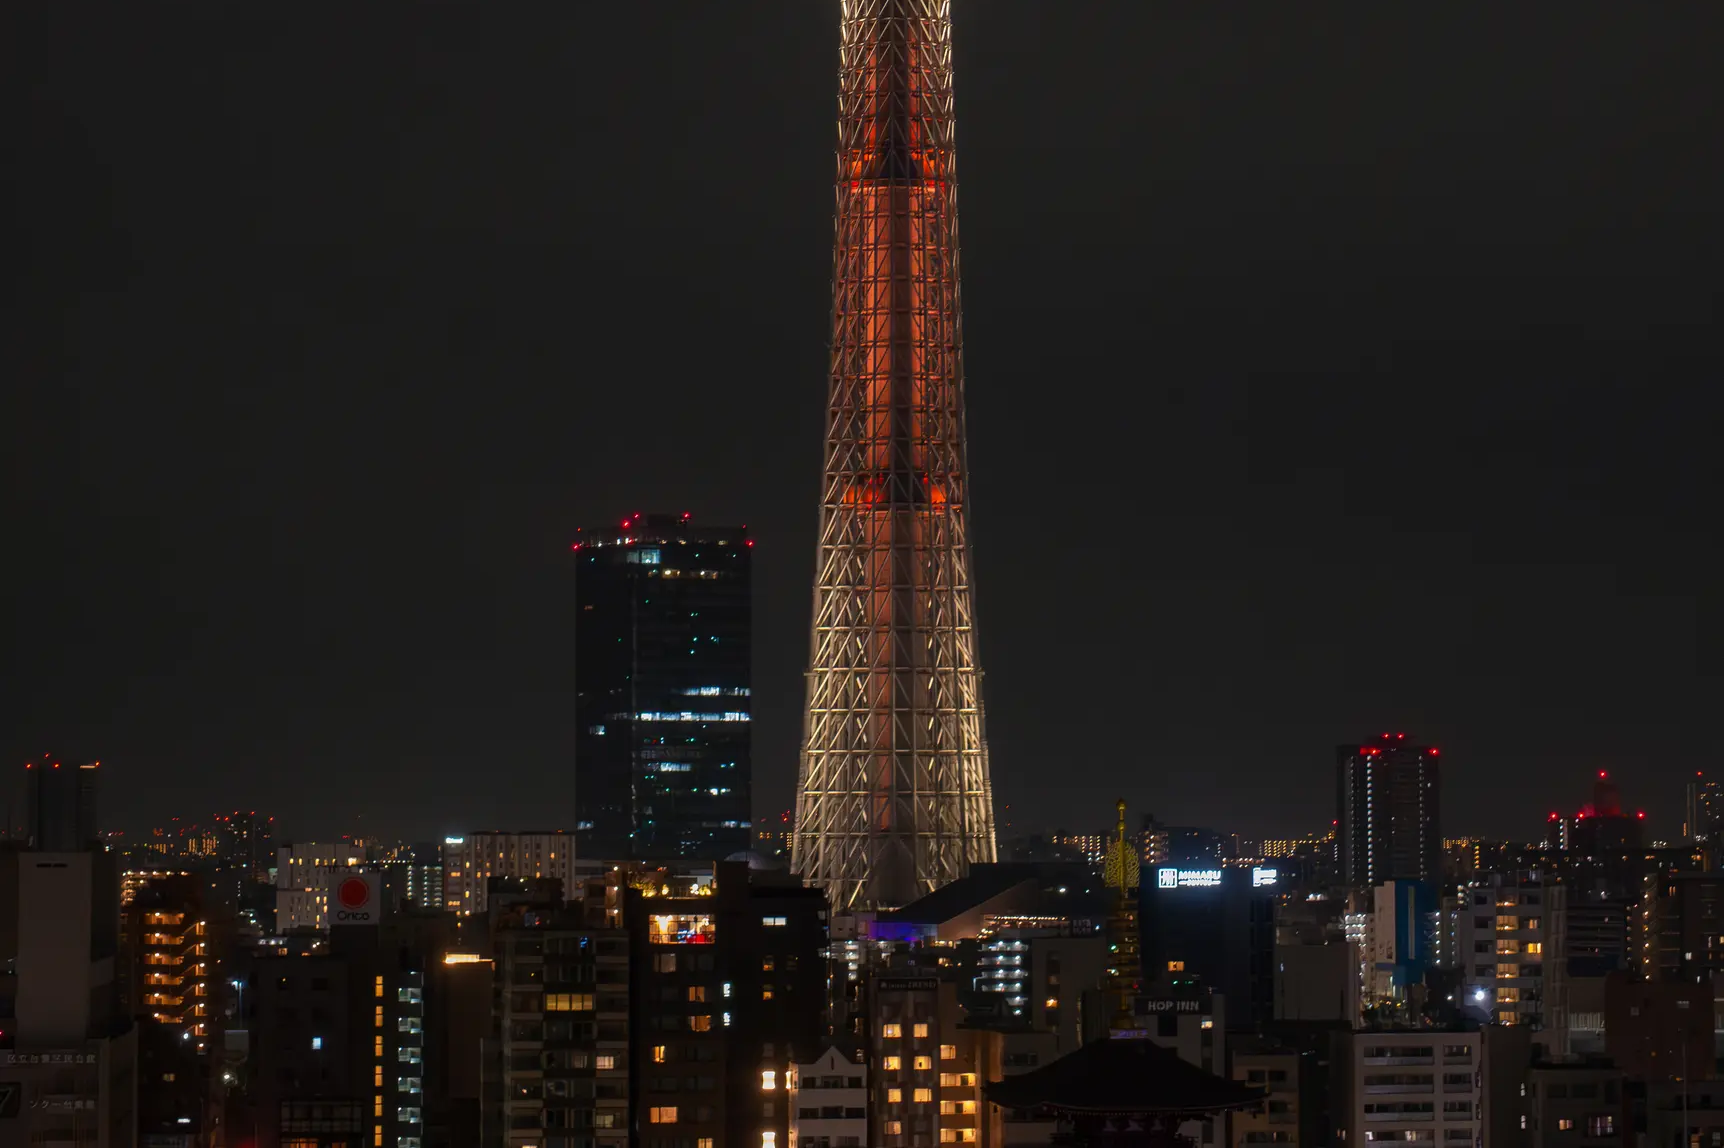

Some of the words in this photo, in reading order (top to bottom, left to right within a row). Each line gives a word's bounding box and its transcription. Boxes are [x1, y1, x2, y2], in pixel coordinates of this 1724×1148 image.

[1178, 870, 1221, 880] MIMARU
[337, 910, 370, 921] Orico
[1147, 1000, 1174, 1012] HOP
[1176, 1000, 1200, 1012] INN
